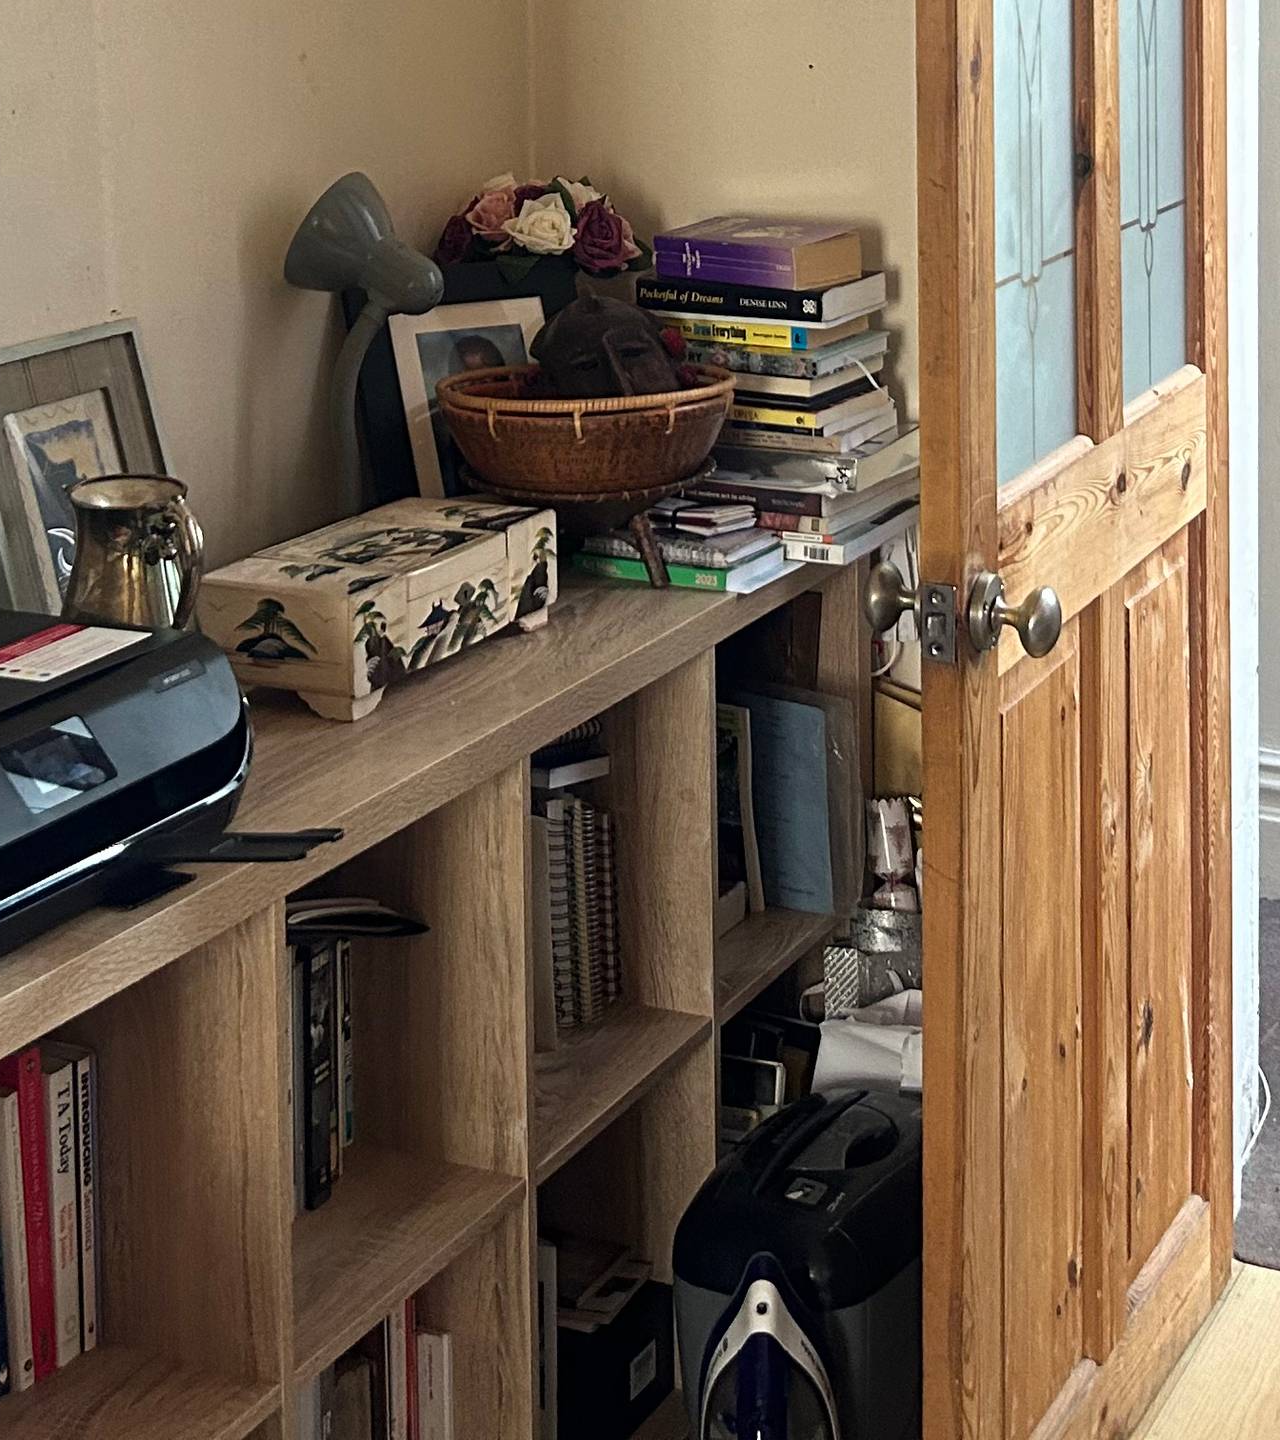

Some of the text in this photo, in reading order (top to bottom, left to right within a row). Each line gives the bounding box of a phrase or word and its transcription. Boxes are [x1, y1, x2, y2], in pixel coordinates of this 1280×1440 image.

[639, 287, 789, 310] Pocketful of Dreams DENISE LINN
[712, 323, 747, 341] Everything
[56, 1117, 71, 1175] Today
[80, 1071, 91, 1186] INTRODUCING
